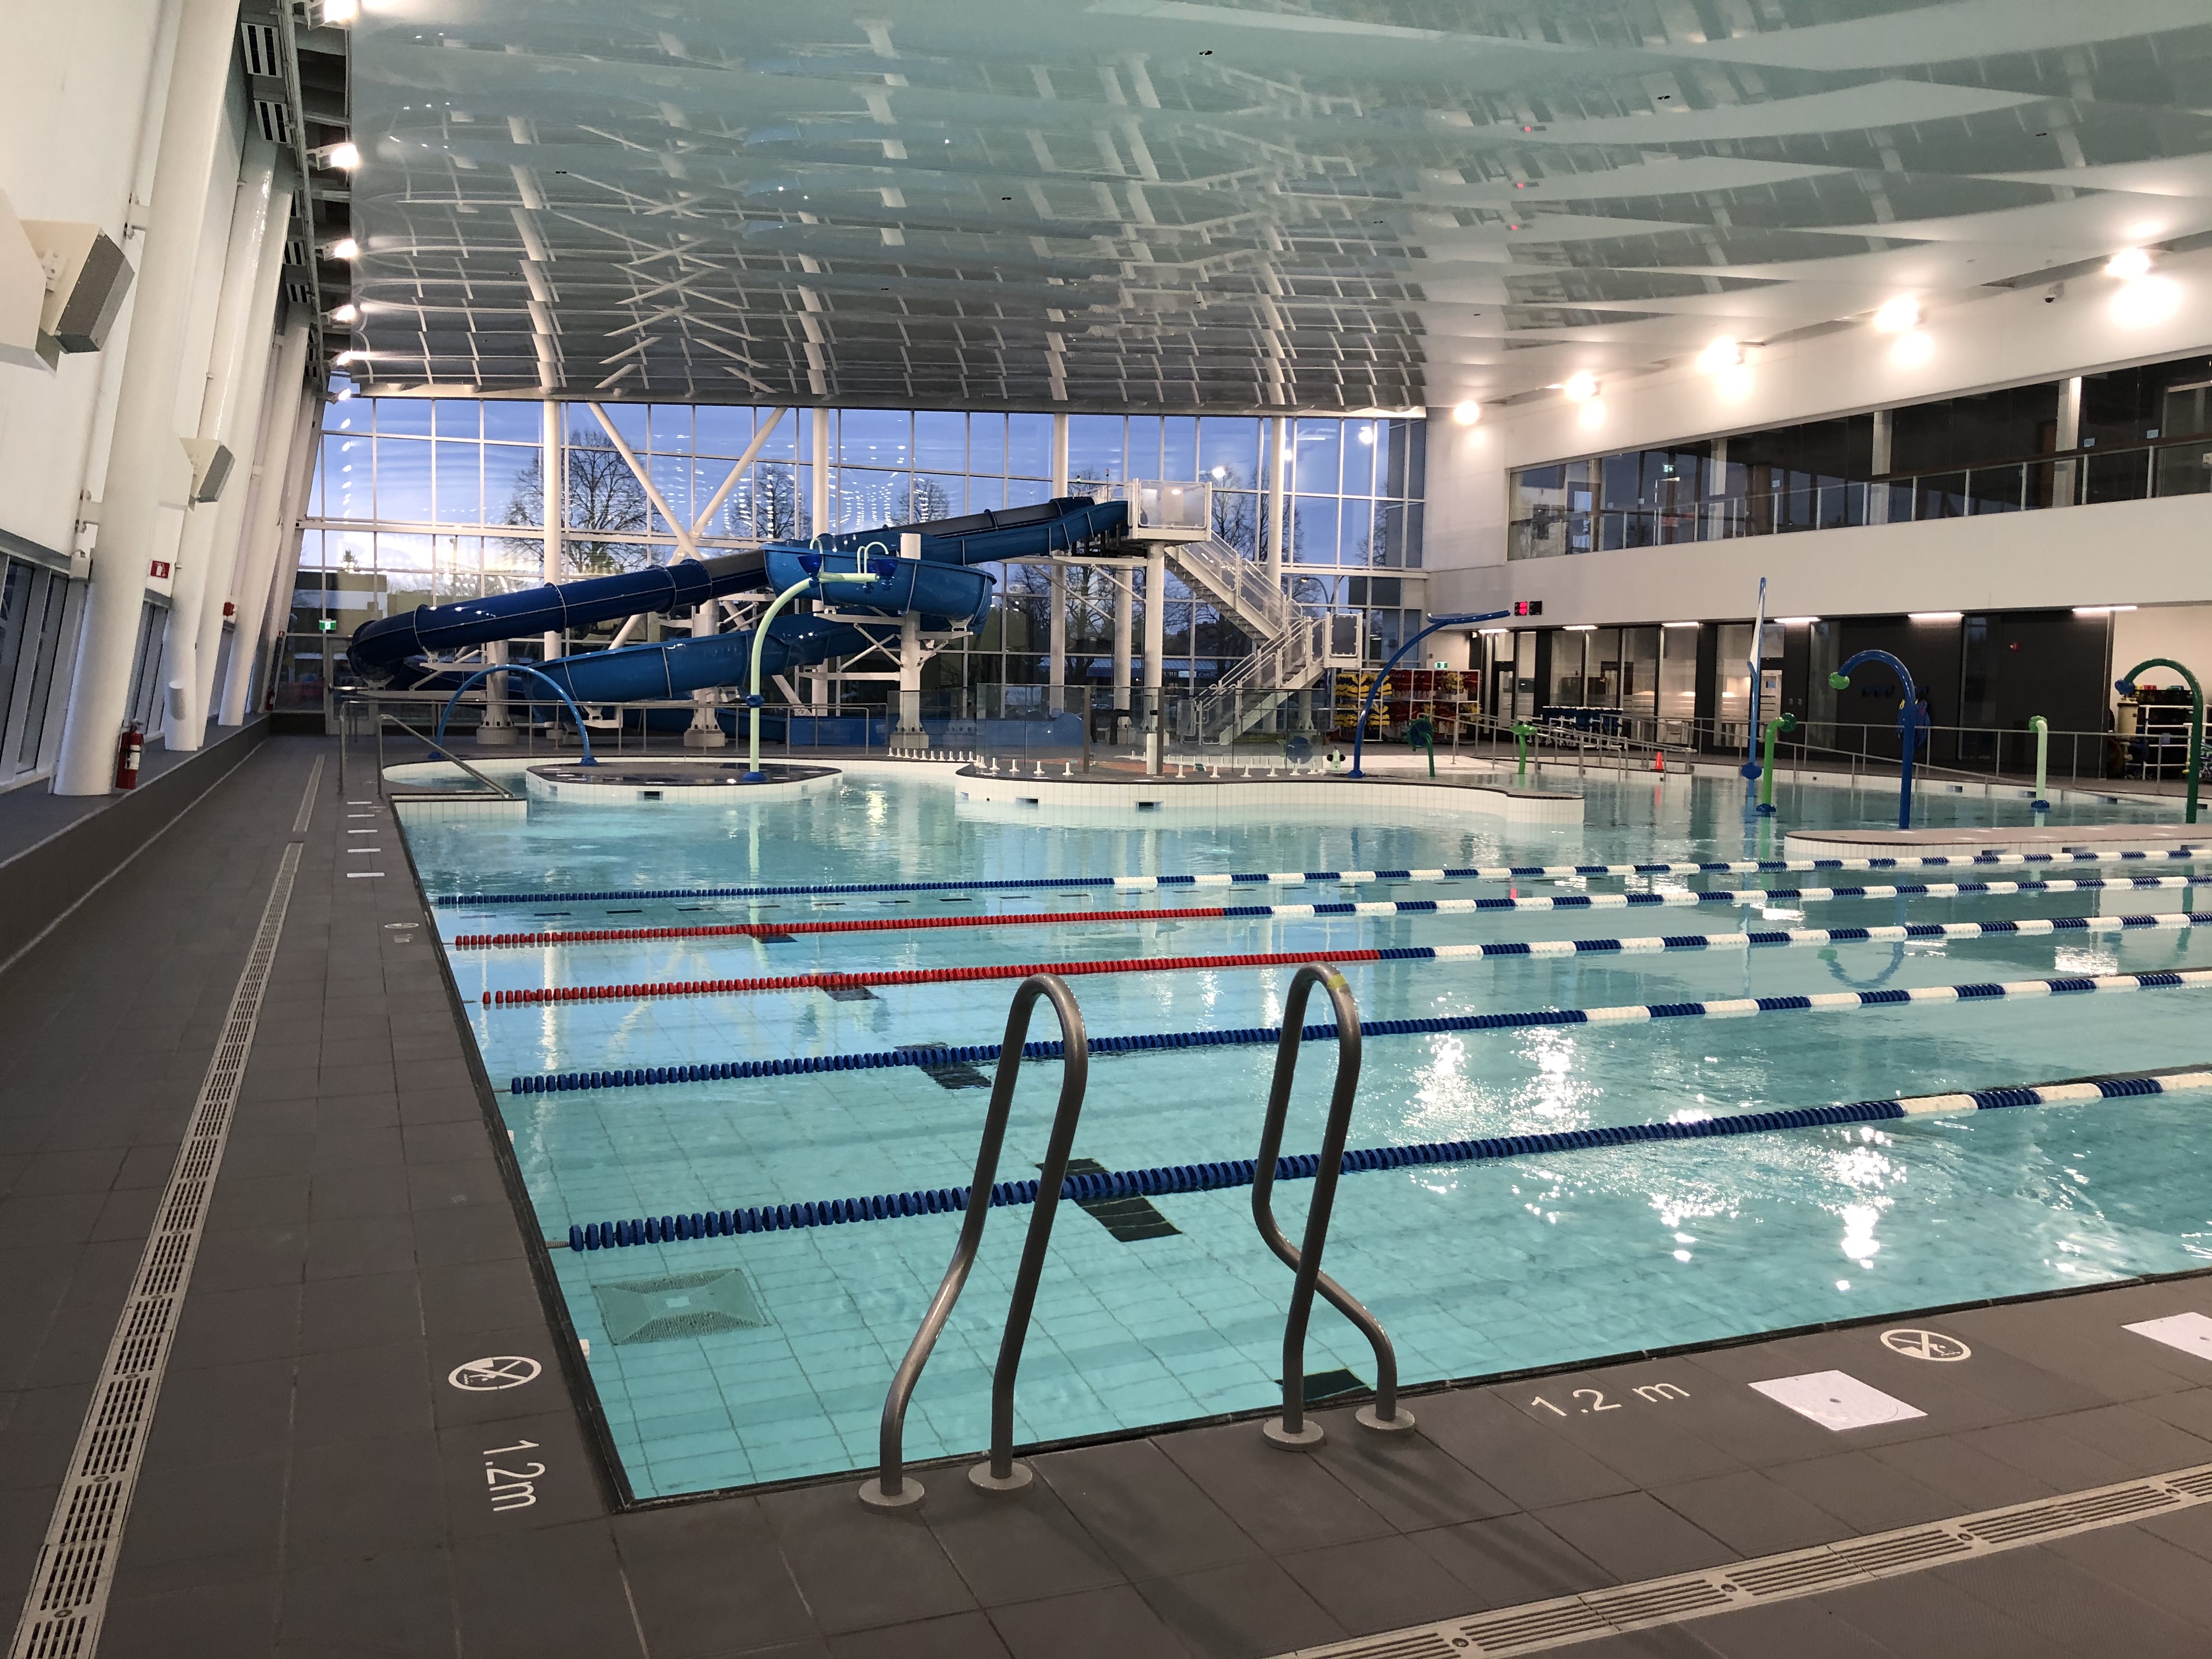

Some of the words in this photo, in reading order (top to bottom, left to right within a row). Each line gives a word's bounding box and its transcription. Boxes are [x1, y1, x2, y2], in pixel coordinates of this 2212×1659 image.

[1531, 1389, 1622, 1417] 1.2
[1632, 1383, 1691, 1402] m
[483, 1440, 546, 1512] 1.2m
